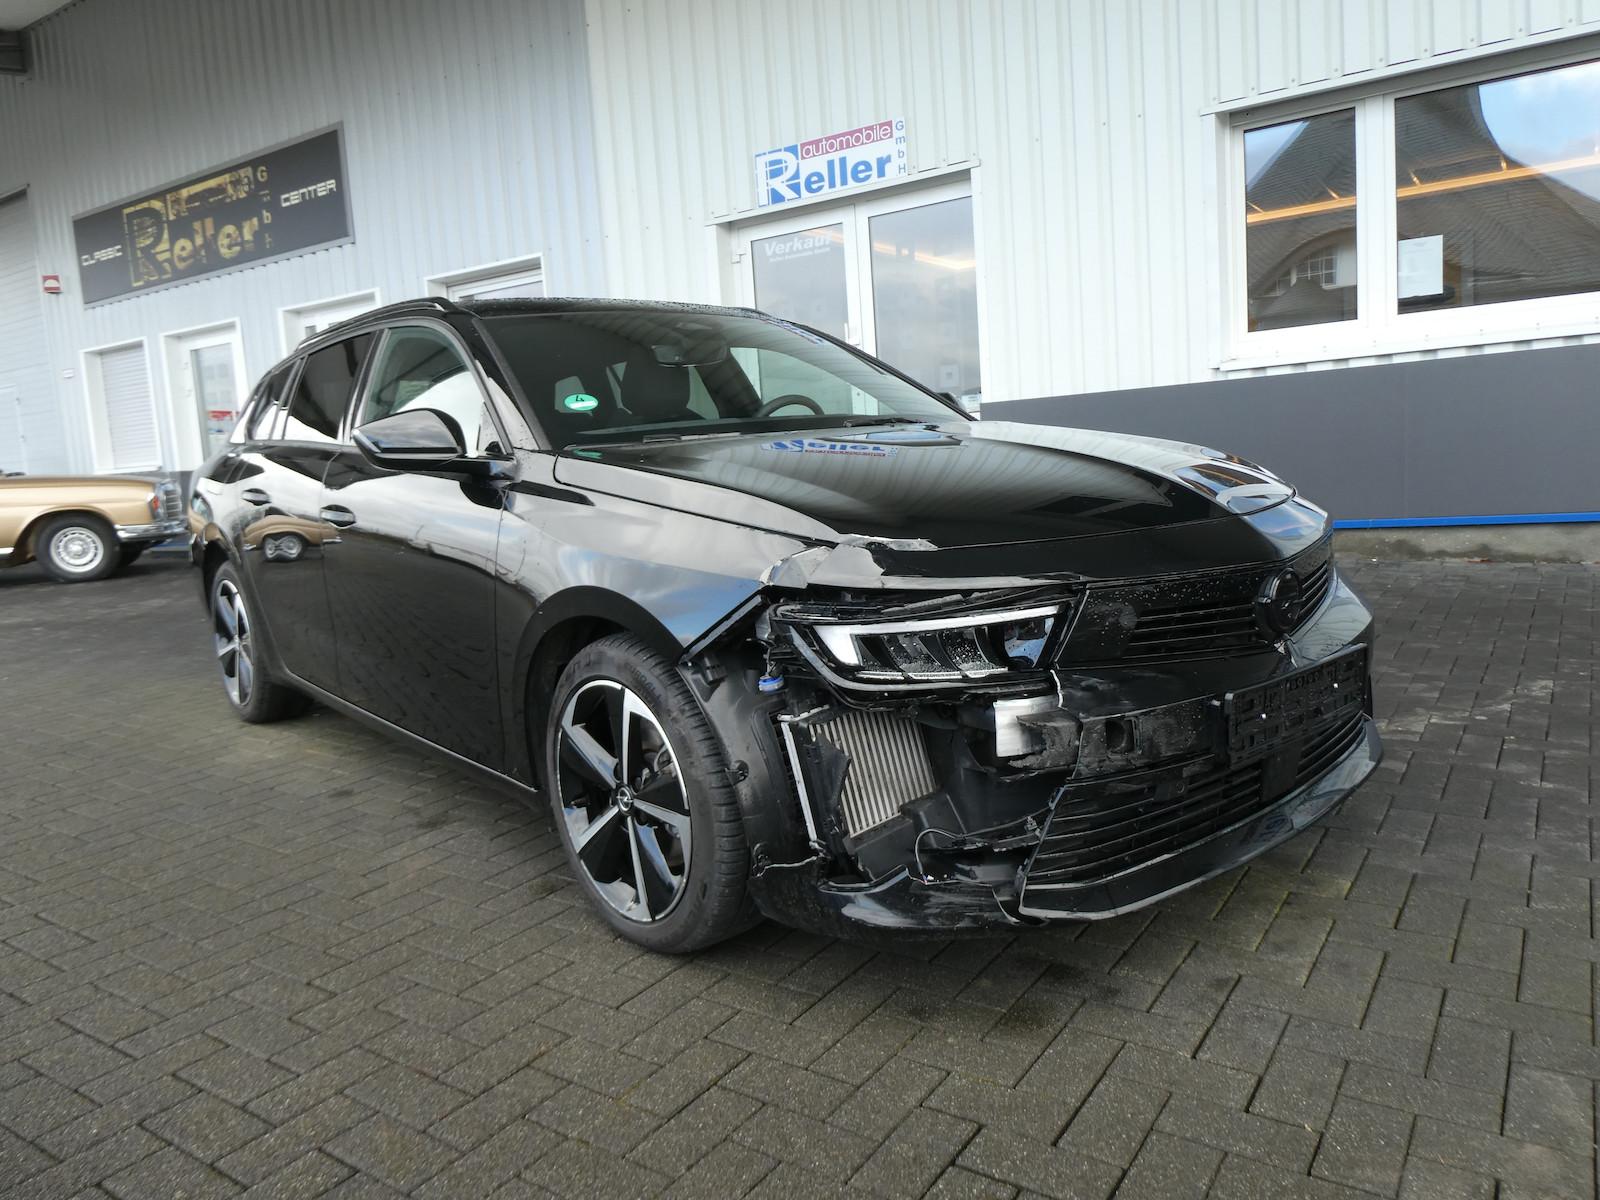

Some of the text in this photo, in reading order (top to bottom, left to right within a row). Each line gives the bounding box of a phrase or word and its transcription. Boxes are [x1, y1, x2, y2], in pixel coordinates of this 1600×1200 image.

[802, 125, 891, 158] automobile
[895, 120, 907, 174] GmbH
[755, 145, 892, 207] Reller
[280, 179, 337, 208] CENTER
[764, 231, 832, 256] Verkauf
